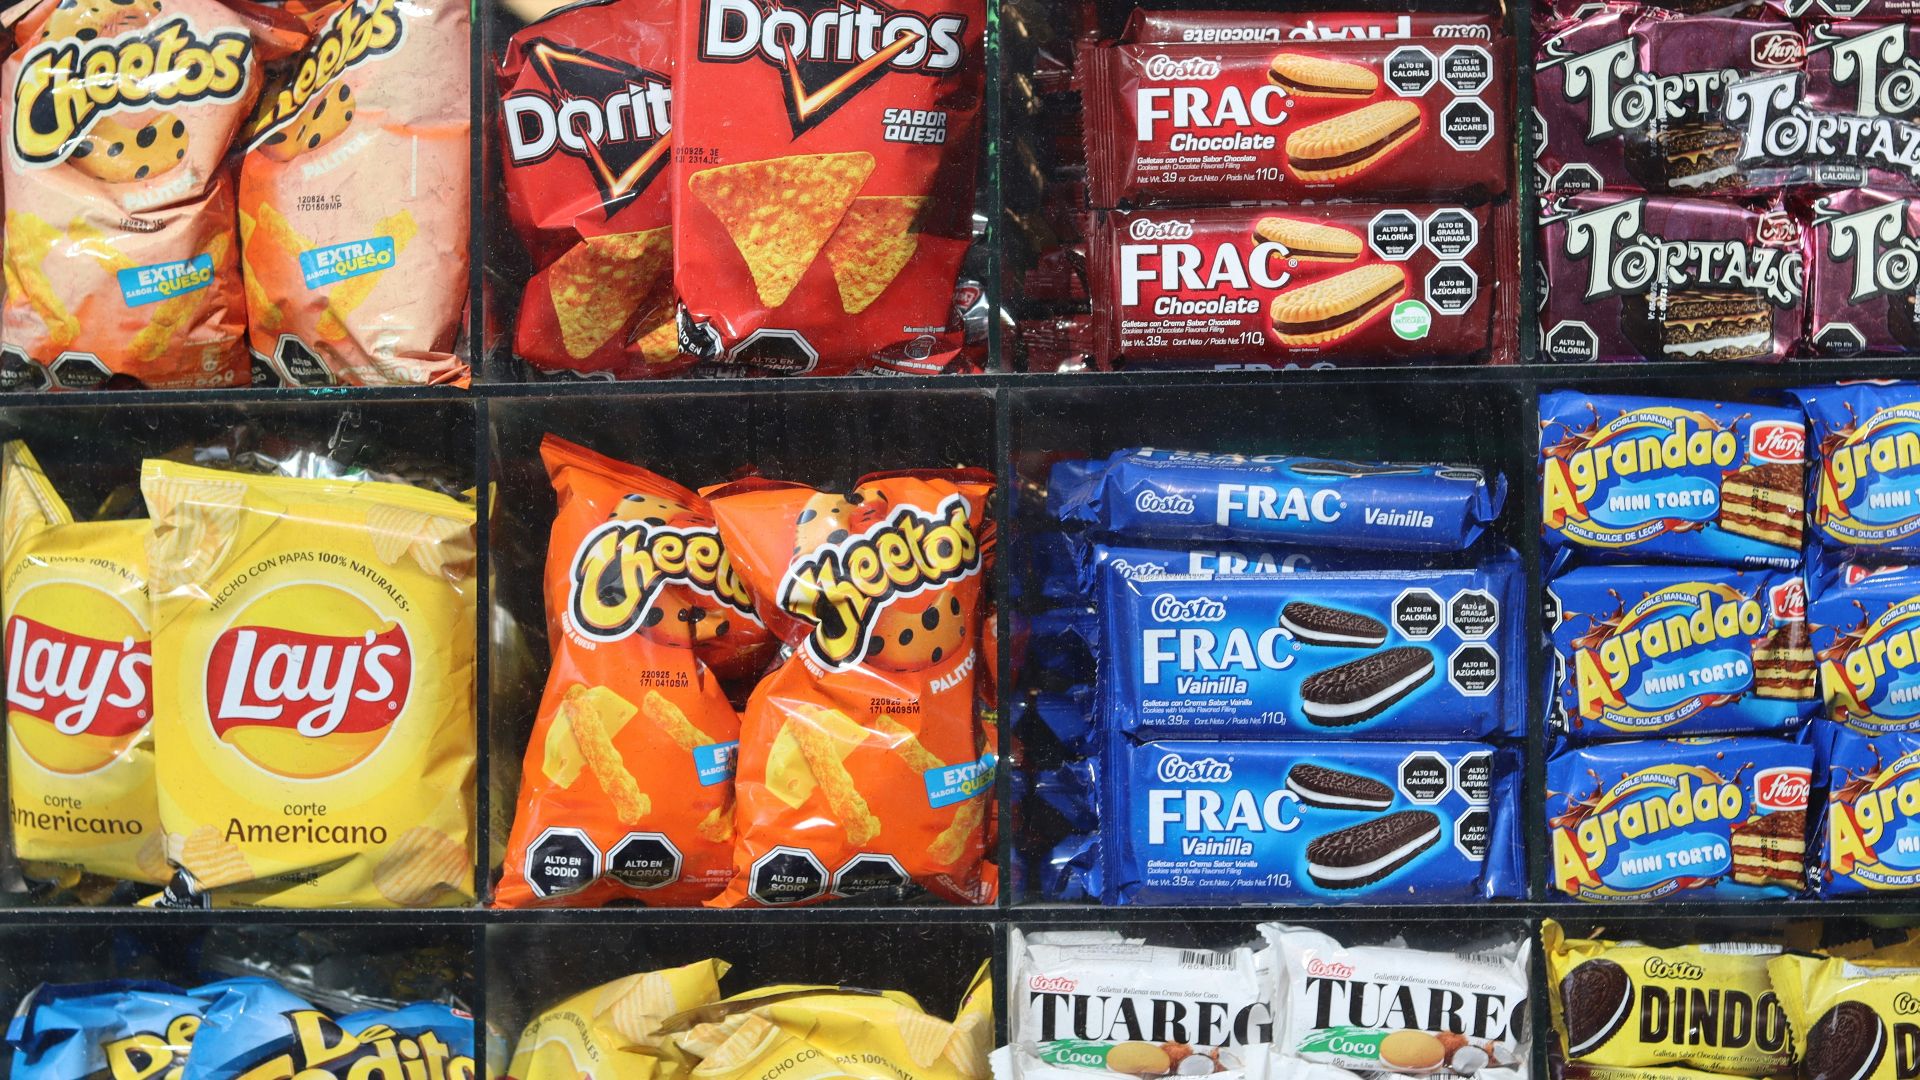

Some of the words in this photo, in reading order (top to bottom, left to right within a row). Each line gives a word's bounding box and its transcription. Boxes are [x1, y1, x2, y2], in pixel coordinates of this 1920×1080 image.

[705, 0, 963, 69] Doritos
[1146, 54, 1222, 80] Costa
[1392, 68, 1430, 77] CALORÍAS
[1446, 71, 1487, 79] SATURADAS
[15, 22, 248, 157] Cheetos
[882, 109, 946, 127] SABOR
[1137, 85, 1288, 141] FRAC
[884, 125, 946, 143] QUESO
[1448, 122, 1488, 132] AZÚCARES
[1170, 133, 1276, 152] Chocolate
[1223, 155, 1257, 163] Chocolate
[1130, 218, 1193, 240] Costa
[1376, 233, 1414, 242] CALORÍAS
[1431, 235, 1471, 243] SATURADAS
[316, 241, 375, 268] EXTRA
[335, 250, 391, 276] QUESO
[137, 261, 197, 286] EXTRA
[158, 267, 211, 296] QUESO
[1121, 242, 1291, 306] FRAC
[1432, 286, 1471, 296] AZÚCARES
[1154, 296, 1260, 316] Chocolate
[1552, 346, 1591, 355] CALORIAS
[1609, 419, 1637, 432] DOBLE
[1639, 414, 1673, 428] MANJAR
[1543, 418, 1738, 529] Agrandao
[1135, 489, 1195, 514] Costa
[1217, 483, 1342, 526] FRAC
[1609, 495, 1654, 512] MINI
[1657, 491, 1716, 510] TORTA
[1870, 489, 1911, 509] MINI
[1364, 507, 1434, 529] Vainilla
[1567, 524, 1594, 538] DOBLE
[1596, 533, 1624, 543] DULCE
[1625, 532, 1637, 542] DE
[1638, 521, 1665, 539] LECHE
[1830, 521, 1855, 536] DOBLE
[1857, 528, 1884, 539] DULCE
[1886, 528, 1898, 538] DE
[213, 574, 248, 609] HECHO
[249, 559, 277, 577] CON
[279, 551, 315, 565] PAPAS
[318, 552, 347, 567] 100%
[349, 560, 408, 610] NATURALES
[788, 505, 977, 662] Cheetos
[1152, 593, 1226, 622] Costa
[1636, 598, 1662, 614] DOBLE
[1663, 594, 1697, 604] MANJAR
[1400, 612, 1437, 621] CALORÍAS
[1143, 627, 1295, 684] FRAC
[1575, 591, 1762, 722] Agrandao
[6, 618, 151, 735] Lay's
[641, 671, 670, 679] 220925
[930, 648, 977, 694] PALITOS
[1455, 666, 1495, 676] AZÚCARES
[1645, 671, 1685, 694] MINI
[1692, 659, 1748, 684] TORTA
[217, 629, 401, 737] Lay's
[655, 680, 689, 688] 0410SM
[1177, 676, 1248, 695] Vainilla
[1185, 699, 1207, 707] Crema
[1606, 712, 1634, 724] DOBLE
[1635, 716, 1663, 725] DULCE
[1664, 715, 1676, 724] DE
[1677, 700, 1701, 719] LECHE
[1157, 753, 1232, 782] Costa
[1407, 777, 1444, 785] CALORÍAS
[1614, 780, 1639, 795] DOBLE
[1642, 774, 1676, 785] MANJAR
[43, 795, 82, 809] corte
[283, 801, 327, 816] corte
[1149, 789, 1300, 844] FRAC
[225, 818, 387, 844] Americano
[1552, 775, 1743, 893] Agrandao
[1182, 837, 1253, 855] Vainilla
[544, 855, 567, 865] ALTO
[568, 856, 582, 866] EN
[624, 860, 648, 868] ALTO
[649, 860, 663, 868] EN
[1621, 859, 1662, 877] MINI
[1666, 843, 1726, 868] TORTA
[545, 866, 580, 878] SODIO
[770, 874, 793, 883] ALTO
[795, 875, 808, 884] EN
[1857, 867, 1884, 882] DOBLE
[1886, 874, 1914, 883] DULCE
[771, 883, 804, 892] SODIO
[1307, 958, 1353, 978] Costa
[1643, 957, 1703, 980] Costa
[1029, 974, 1077, 992] Costa
[1374, 972, 1400, 982] Galletas
[1401, 975, 1426, 984] Rellenas
[1440, 978, 1460, 988] Crema
[1462, 981, 1480, 990] Sabor
[1097, 986, 1122, 995] Galletas
[1123, 986, 1149, 995] Rellenas
[1162, 989, 1182, 997] Crema
[1184, 990, 1202, 998] Sabor
[1203, 991, 1219, 999] Coco
[1328, 1036, 1376, 1055] Coco
[1056, 1048, 1103, 1065] Coco
